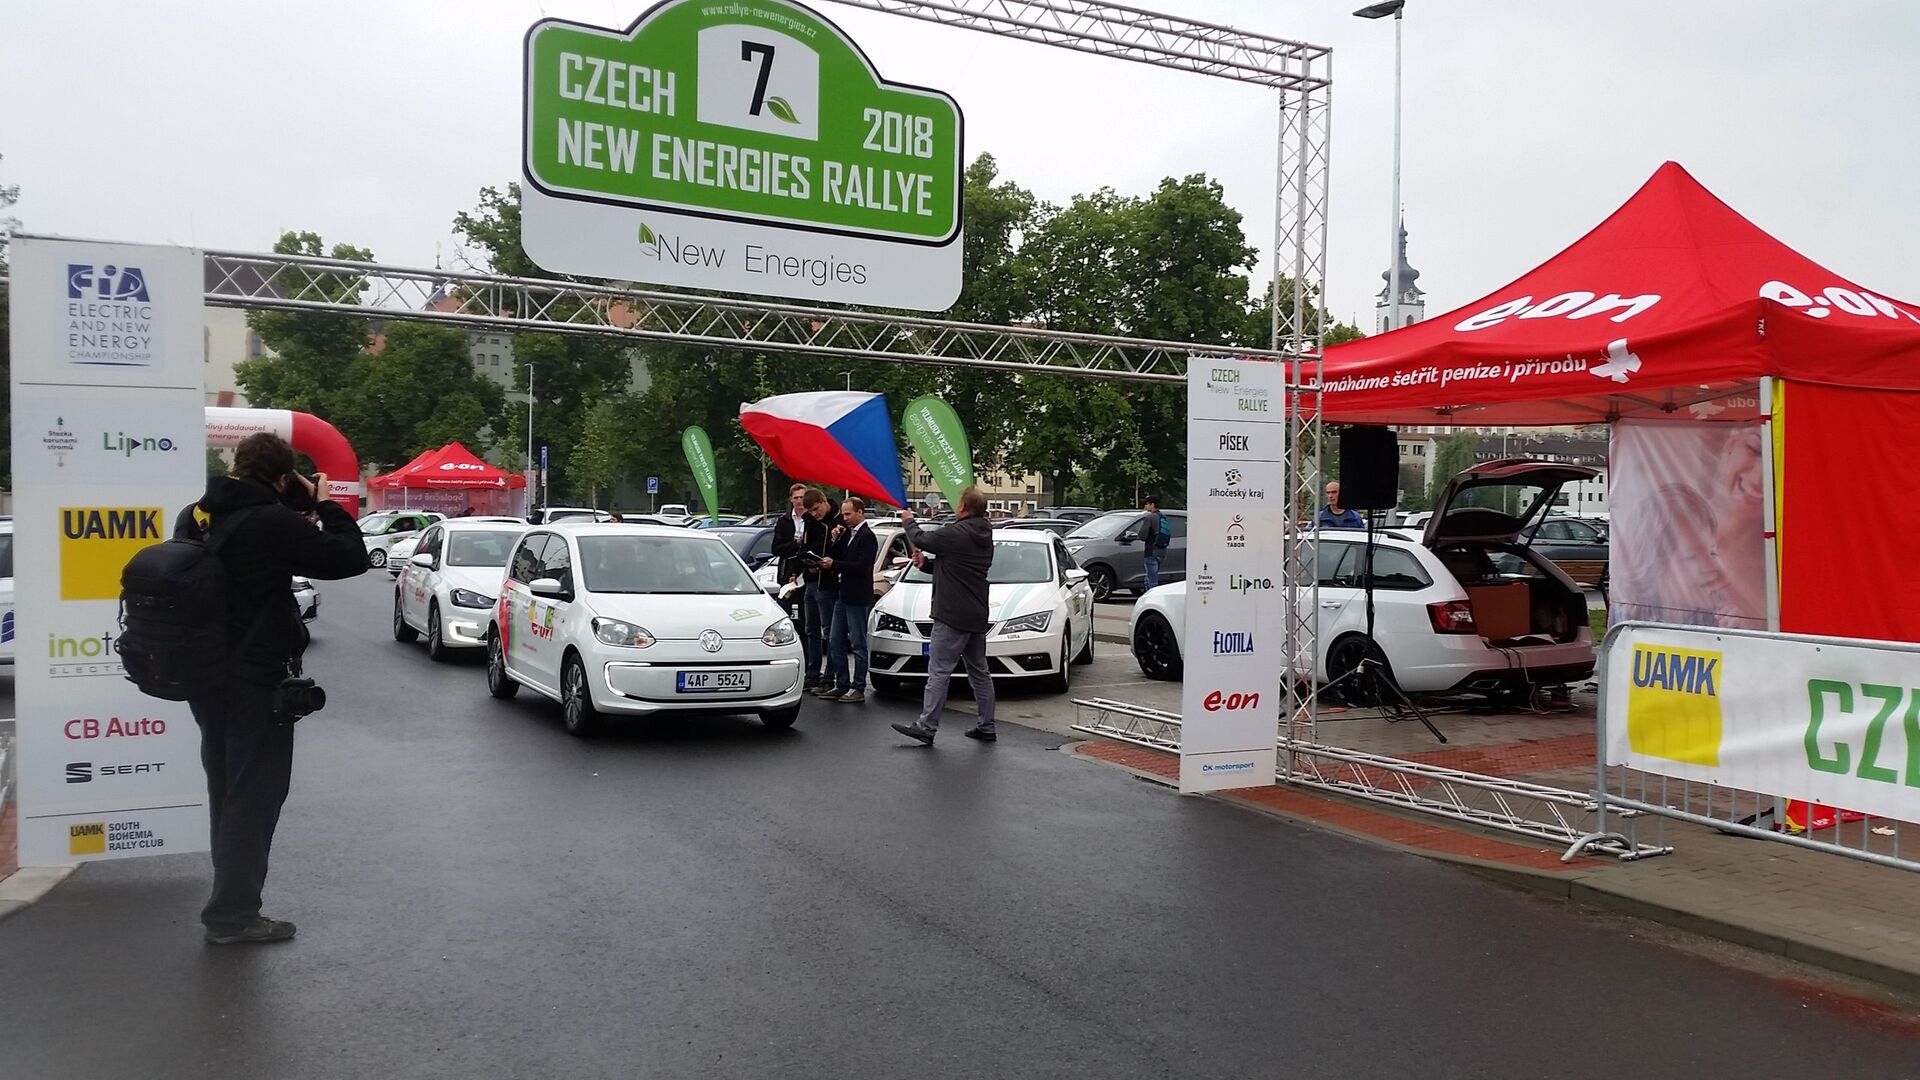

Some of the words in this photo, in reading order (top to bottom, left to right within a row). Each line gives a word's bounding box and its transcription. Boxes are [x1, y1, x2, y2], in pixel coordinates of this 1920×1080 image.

[559, 52, 675, 117] CZECH
[741, 40, 776, 117] 7
[863, 107, 933, 159] 2018
[557, 118, 639, 175] NEW
[651, 133, 811, 200] ENERGIES
[823, 161, 933, 216] RALLYE
[656, 233, 726, 269] New
[745, 245, 867, 286] Energies
[68, 303, 152, 320] ELECTRIC
[69, 321, 104, 333] AND
[111, 321, 150, 333] NEW
[68, 334, 152, 350] ENERGY
[68, 350, 152, 360] CHAMPIONSHIP
[1211, 368, 1240, 383] CZECH
[1391, 366, 1440, 387] šetřit
[1442, 361, 1501, 388] peníze
[1504, 360, 1511, 377] i
[1510, 353, 1588, 384] přírodu
[1211, 384, 1230, 396] New
[1233, 385, 1269, 397] Energies
[1238, 398, 1268, 412] RALLYE
[1219, 431, 1249, 451] PÍSEK
[1208, 488, 1247, 499] Jihočeský
[1248, 488, 1264, 500] kraj
[63, 510, 161, 540] UAMK
[1213, 630, 1254, 654] FLOTILA
[688, 674, 709, 687] 4AP
[717, 673, 745, 686] 5524
[1633, 650, 1718, 697] UAMK
[64, 718, 100, 740] CB
[105, 717, 166, 738] Auto
[100, 762, 166, 776] SEAT
[1214, 762, 1254, 770] motorsport
[70, 824, 104, 837] UAMK
[108, 821, 140, 832] SOUTH
[108, 829, 154, 842] BOHEMIA
[108, 839, 137, 851] RALLY
[138, 838, 165, 849] CLUB
